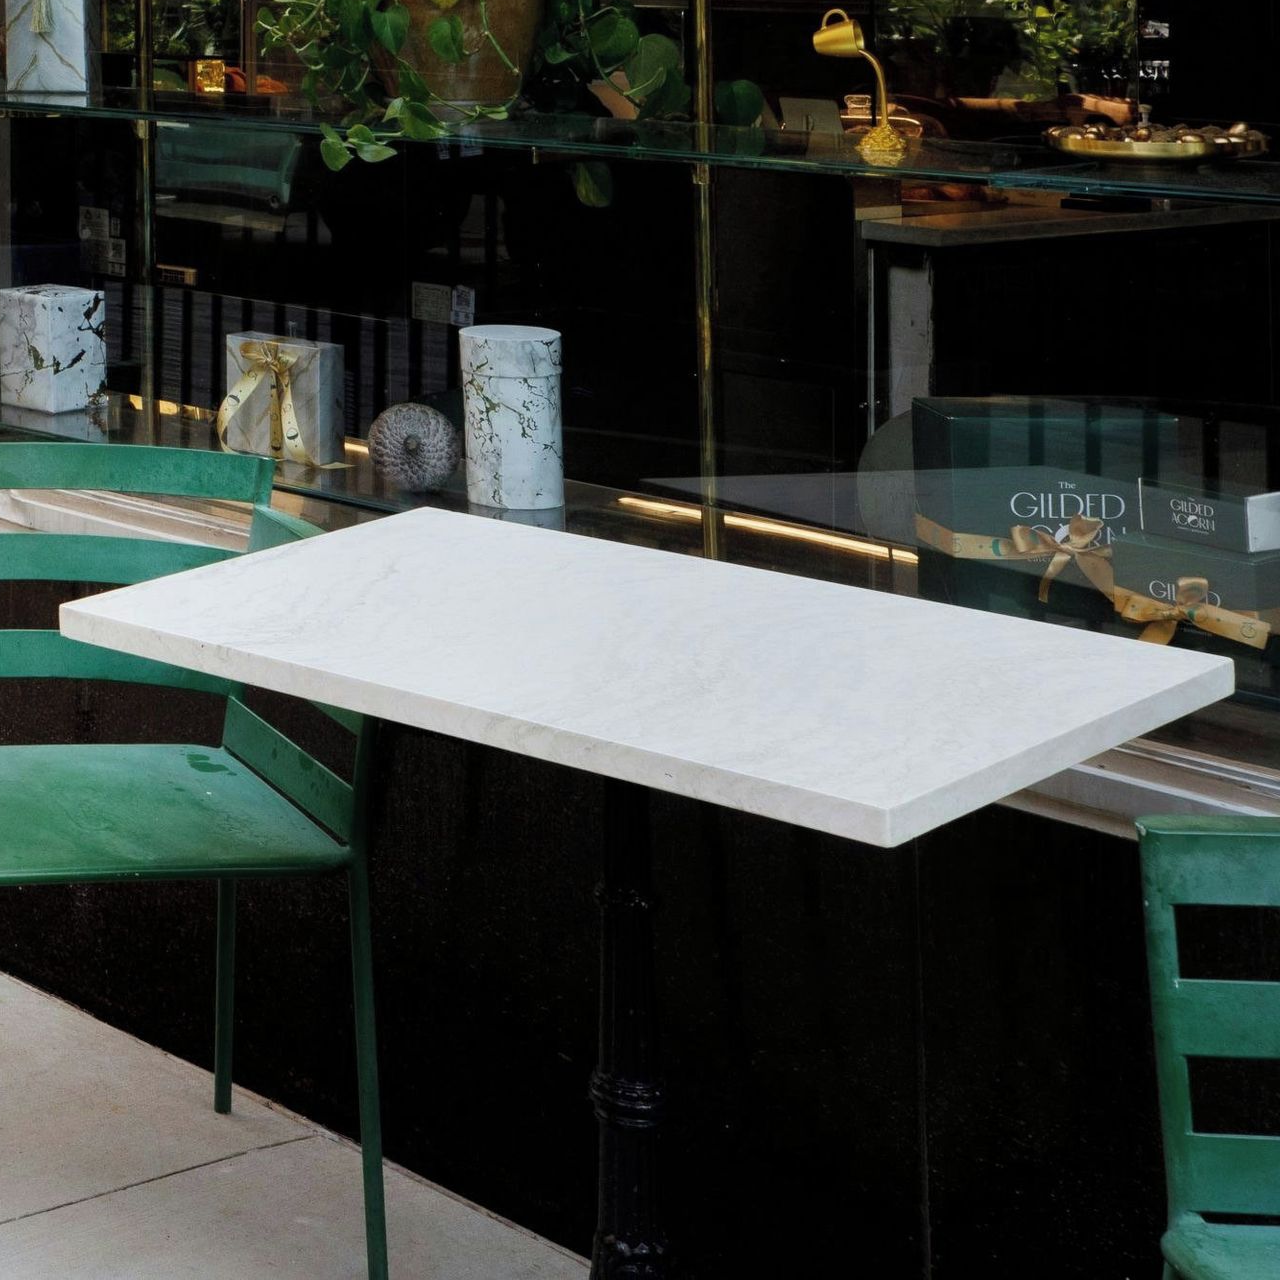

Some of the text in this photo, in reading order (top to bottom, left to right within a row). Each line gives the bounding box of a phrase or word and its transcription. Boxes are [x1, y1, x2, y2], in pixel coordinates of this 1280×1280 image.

[1058, 481, 1076, 489] The
[1010, 492, 1125, 520] GILDED
[1169, 498, 1214, 518] GILDED
[1171, 511, 1215, 532] ACORN
